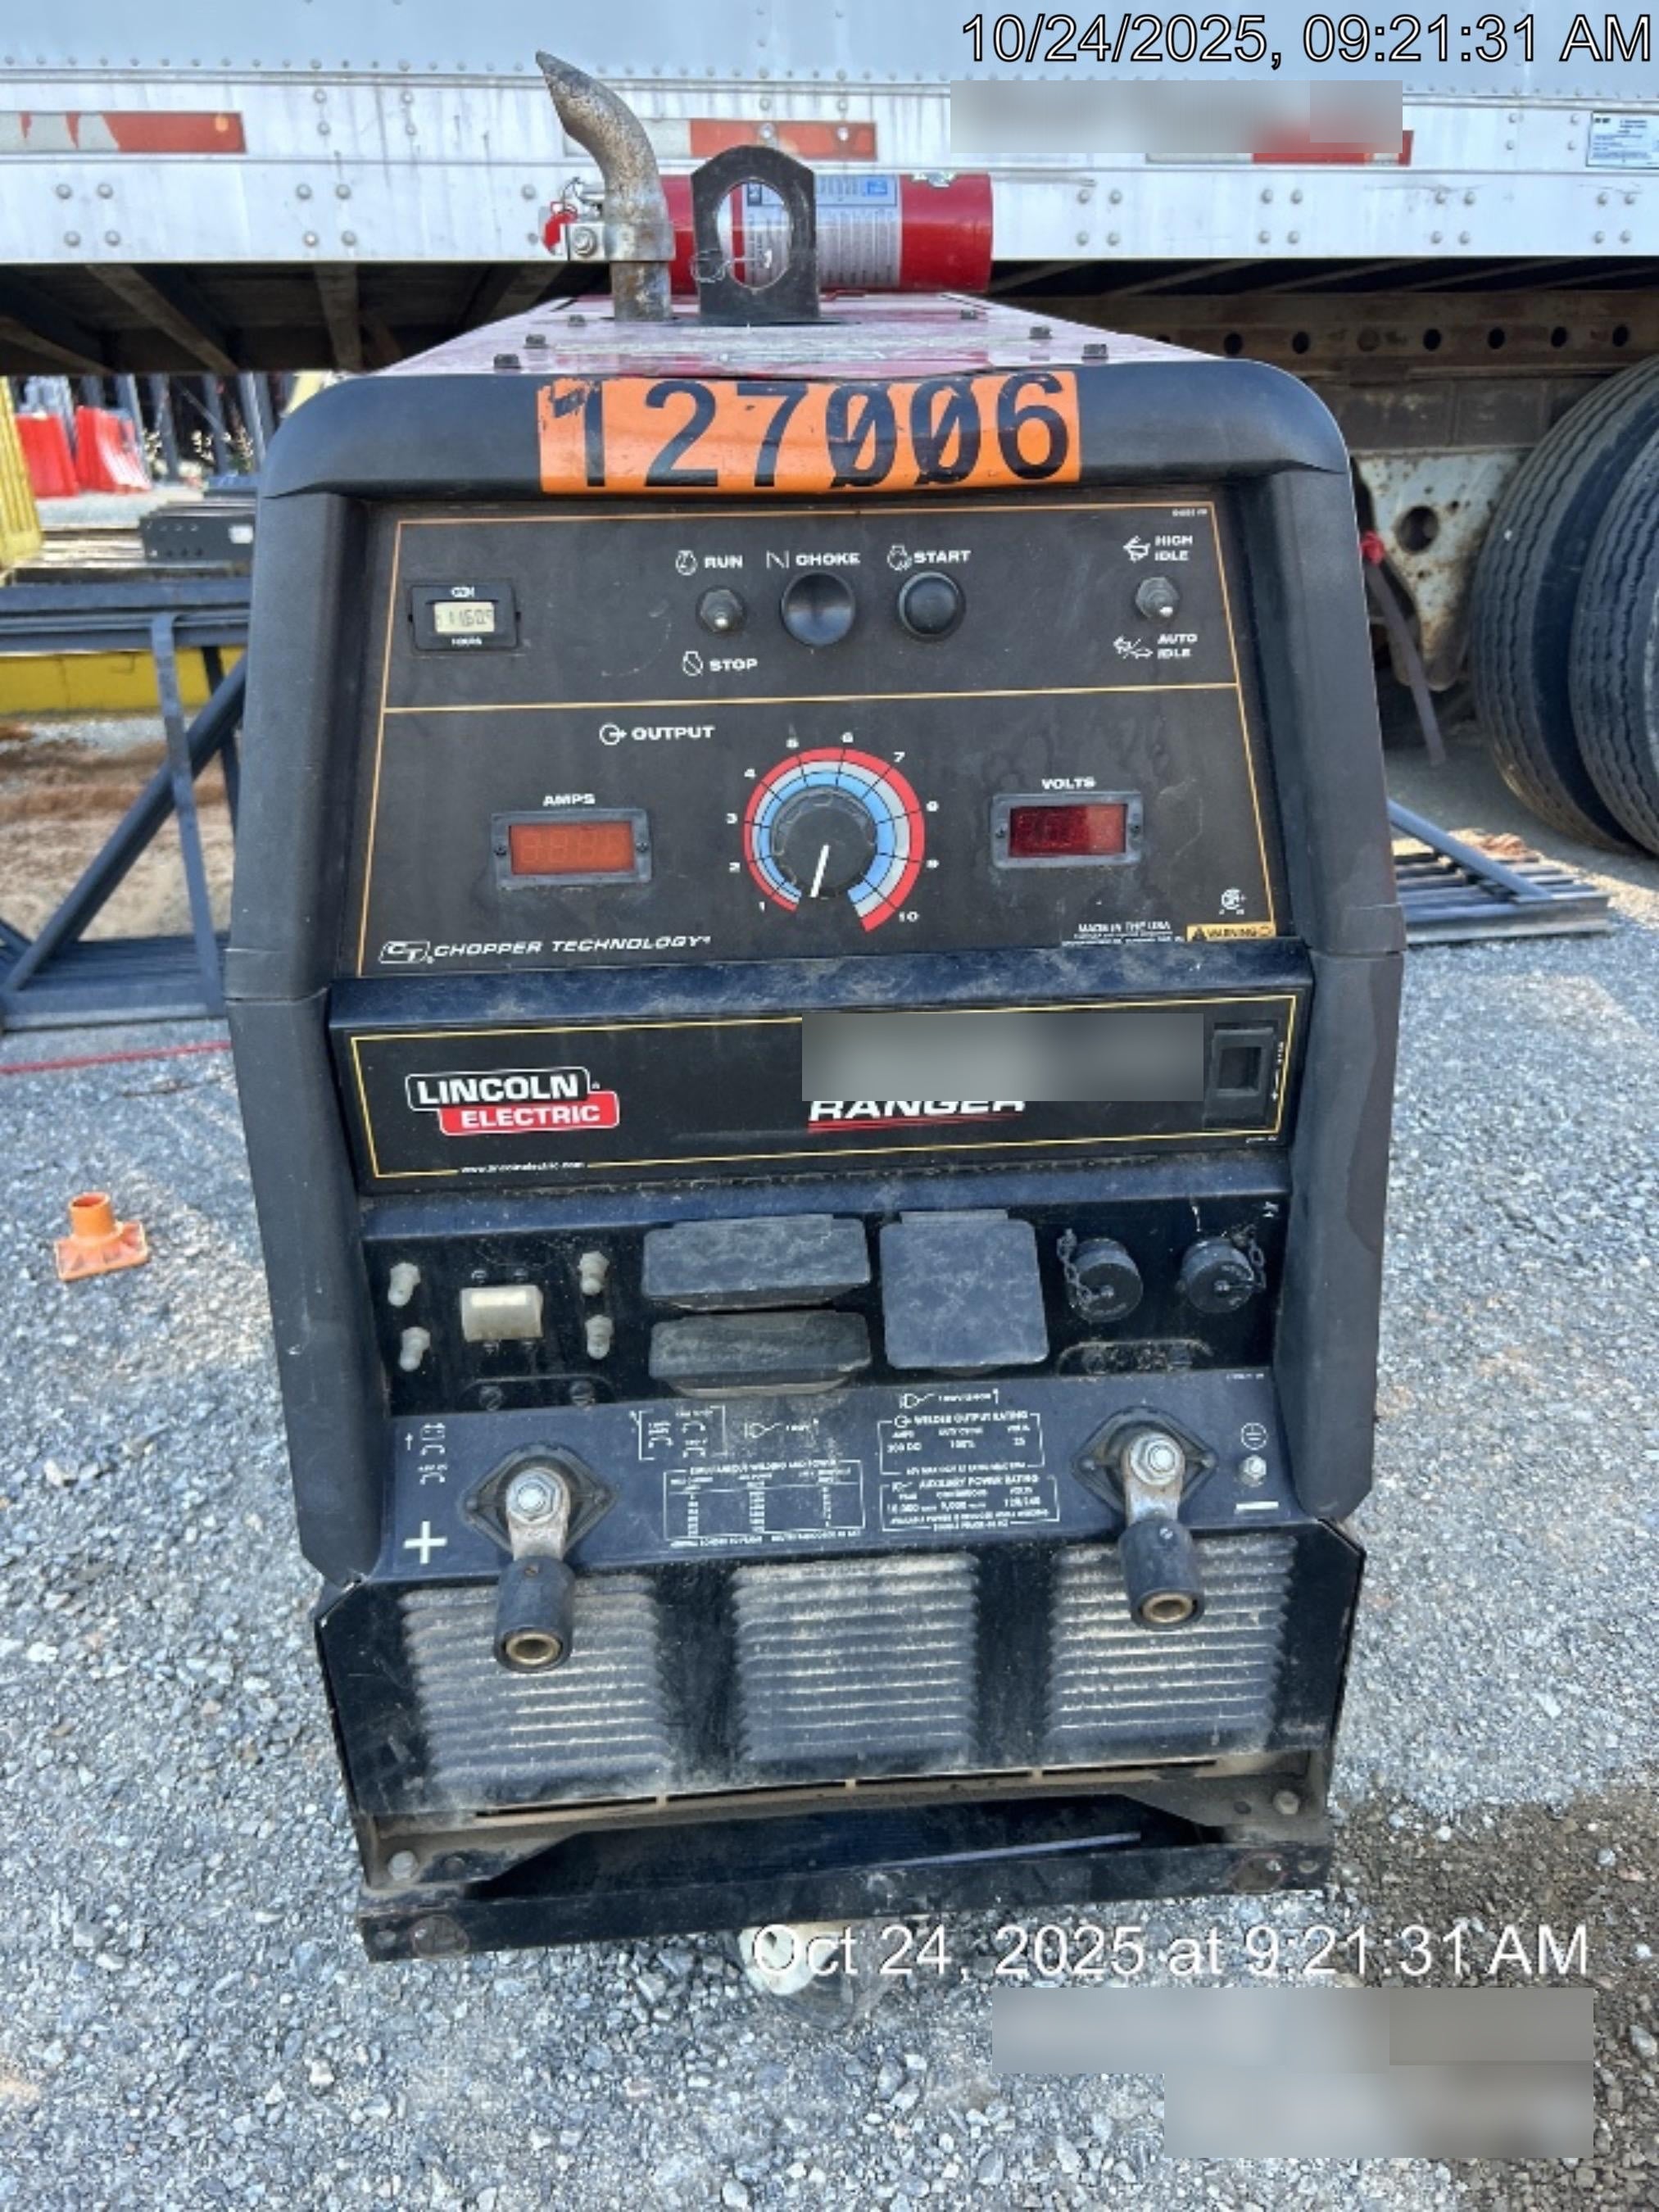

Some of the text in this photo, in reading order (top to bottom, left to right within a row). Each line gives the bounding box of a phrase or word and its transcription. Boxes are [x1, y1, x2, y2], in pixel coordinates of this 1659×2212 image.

[552, 370, 1068, 489] 127006
[1154, 535, 1194, 546] HIGH
[704, 555, 743, 569] RUN
[795, 552, 861, 566] CHOKE
[913, 550, 972, 564] START
[1154, 550, 1190, 561] IDLE
[1157, 632, 1199, 645] AUTO
[1157, 647, 1191, 660] IDLE
[709, 658, 759, 672] STOP
[631, 725, 716, 741] OUTPUT
[893, 751, 905, 763] 7
[744, 768, 756, 779] 4
[1040, 776, 1098, 791] VOLTS
[542, 793, 596, 807] AMPS
[727, 812, 738, 825] 3
[728, 862, 741, 873] 2
[899, 911, 919, 922] 10
[434, 936, 702, 958] CHOPPER TECHNOLOGY
[417, 1074, 578, 1105] LINCOLN
[461, 1105, 601, 1130] ELECTRIC
